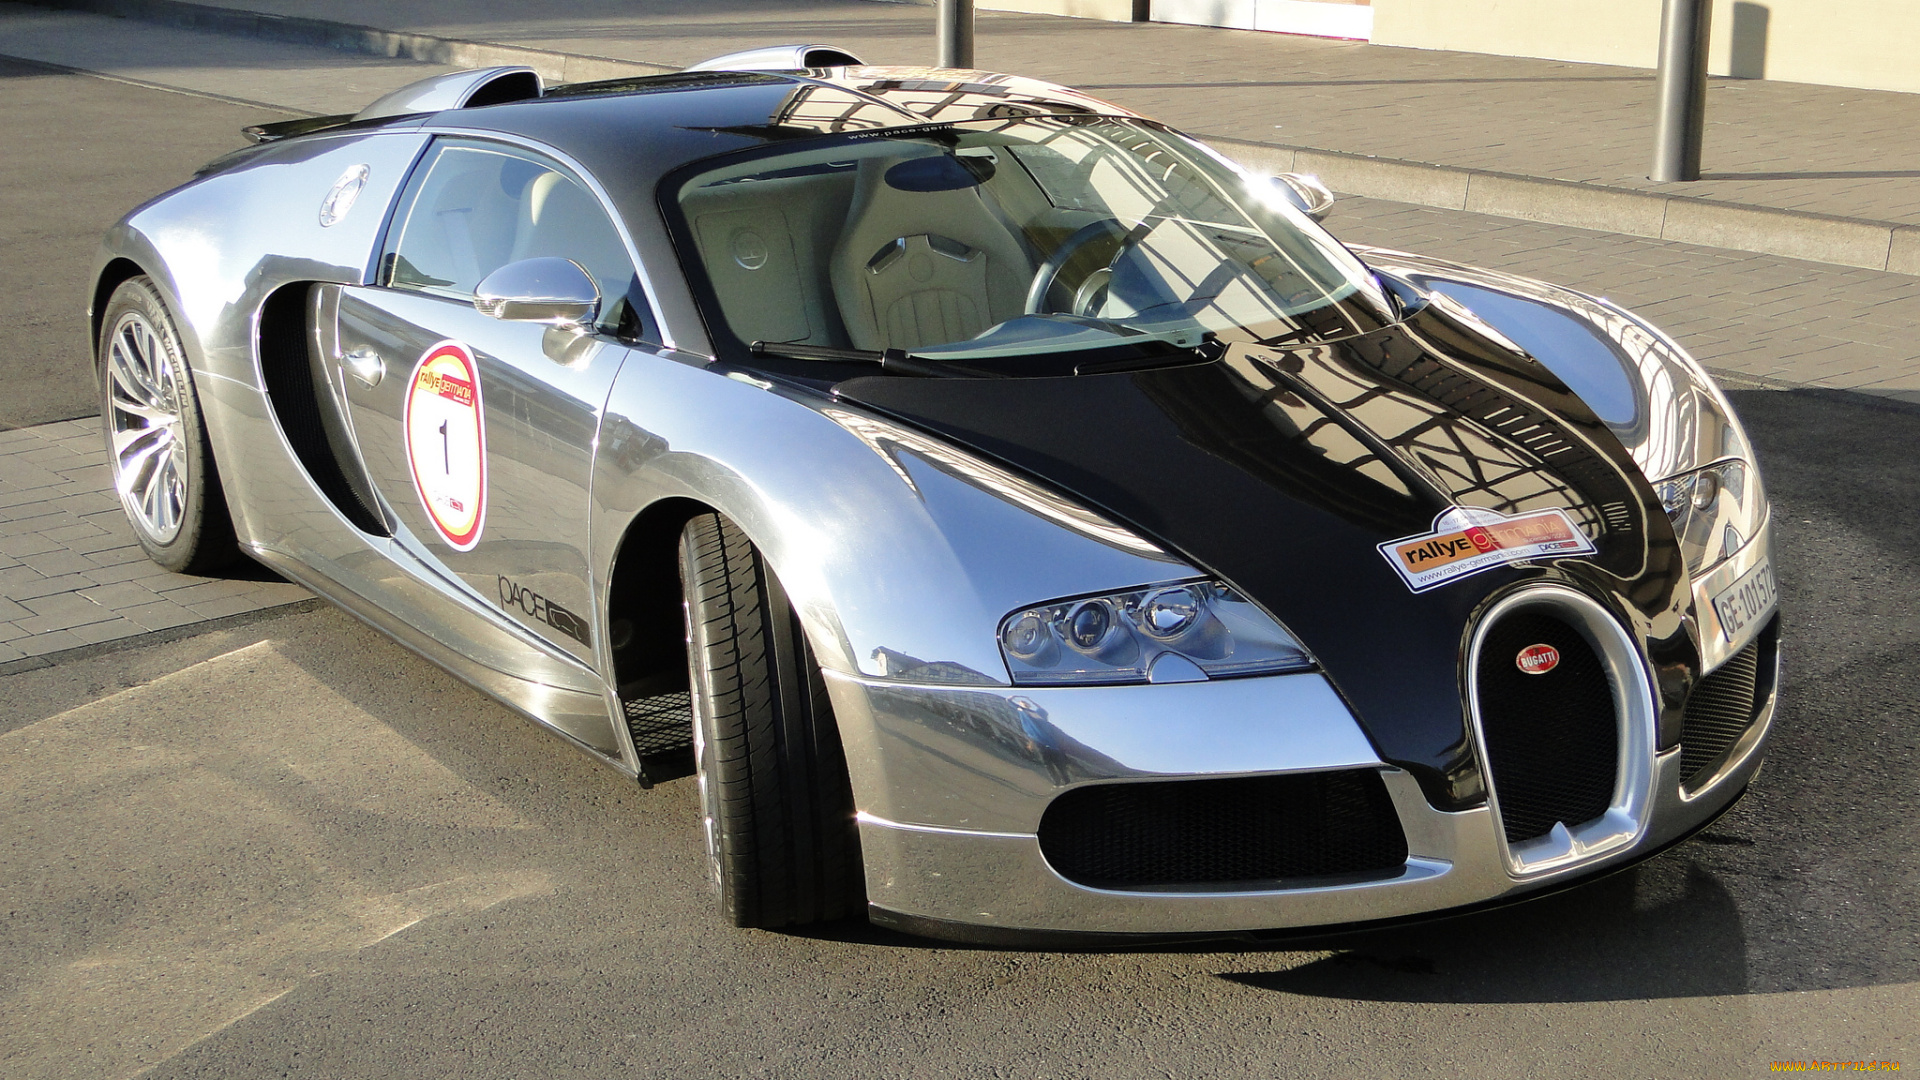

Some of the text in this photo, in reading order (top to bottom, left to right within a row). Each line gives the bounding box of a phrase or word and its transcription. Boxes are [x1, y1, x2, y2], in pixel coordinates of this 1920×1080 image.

[162, 337, 189, 407] MICHELIN
[439, 418, 449, 475] 1
[1417, 547, 1530, 583] www.rallye-germania.com
[1520, 650, 1556, 669] BUGATTI
